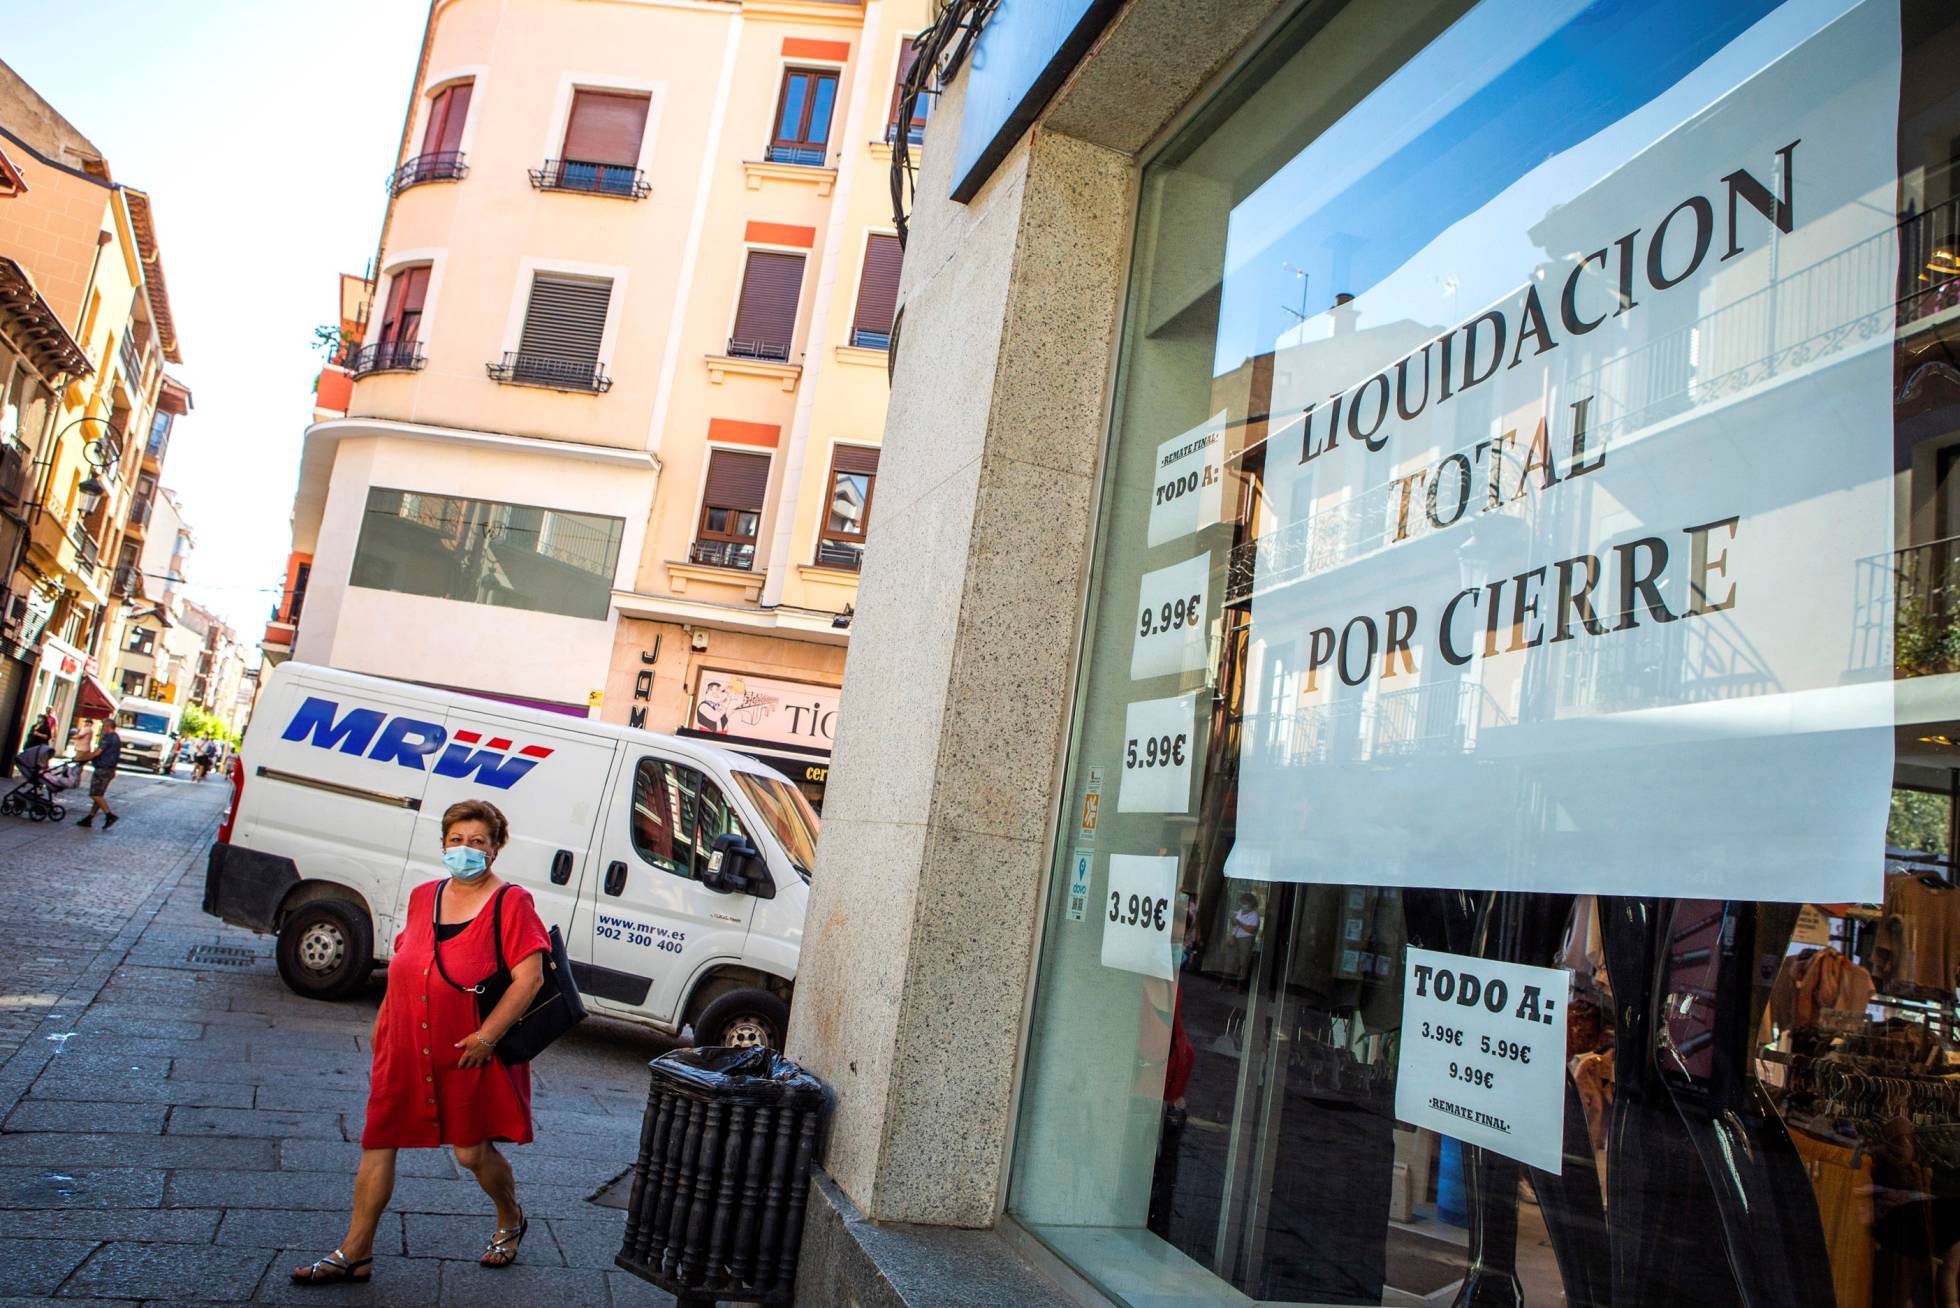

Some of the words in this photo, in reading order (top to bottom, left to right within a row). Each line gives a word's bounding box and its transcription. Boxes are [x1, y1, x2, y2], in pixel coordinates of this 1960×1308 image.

[1298, 139, 1802, 466] LIQUIDACION
[1156, 471, 1198, 506] TODO
[1202, 465, 1219, 487] A:
[1389, 395, 1608, 543] TOTAL
[1140, 594, 1201, 637] 9.99€
[1303, 605, 1420, 693] POR
[1438, 515, 1740, 666] CIERRE
[281, 697, 554, 789] MRW
[1126, 734, 1186, 769] 5.99€
[599, 915, 686, 941] www.mrw.es
[1109, 891, 1168, 931] 3.99€
[596, 926, 621, 940] 902
[626, 932, 651, 947] 300
[657, 939, 683, 954] 400
[1414, 964, 1508, 1013] TODO
[1515, 985, 1555, 1025] A:
[1421, 1022, 1464, 1047] 3.99€
[1480, 1035, 1531, 1064] 5.99€
[1449, 1062, 1494, 1089] 9.99€
